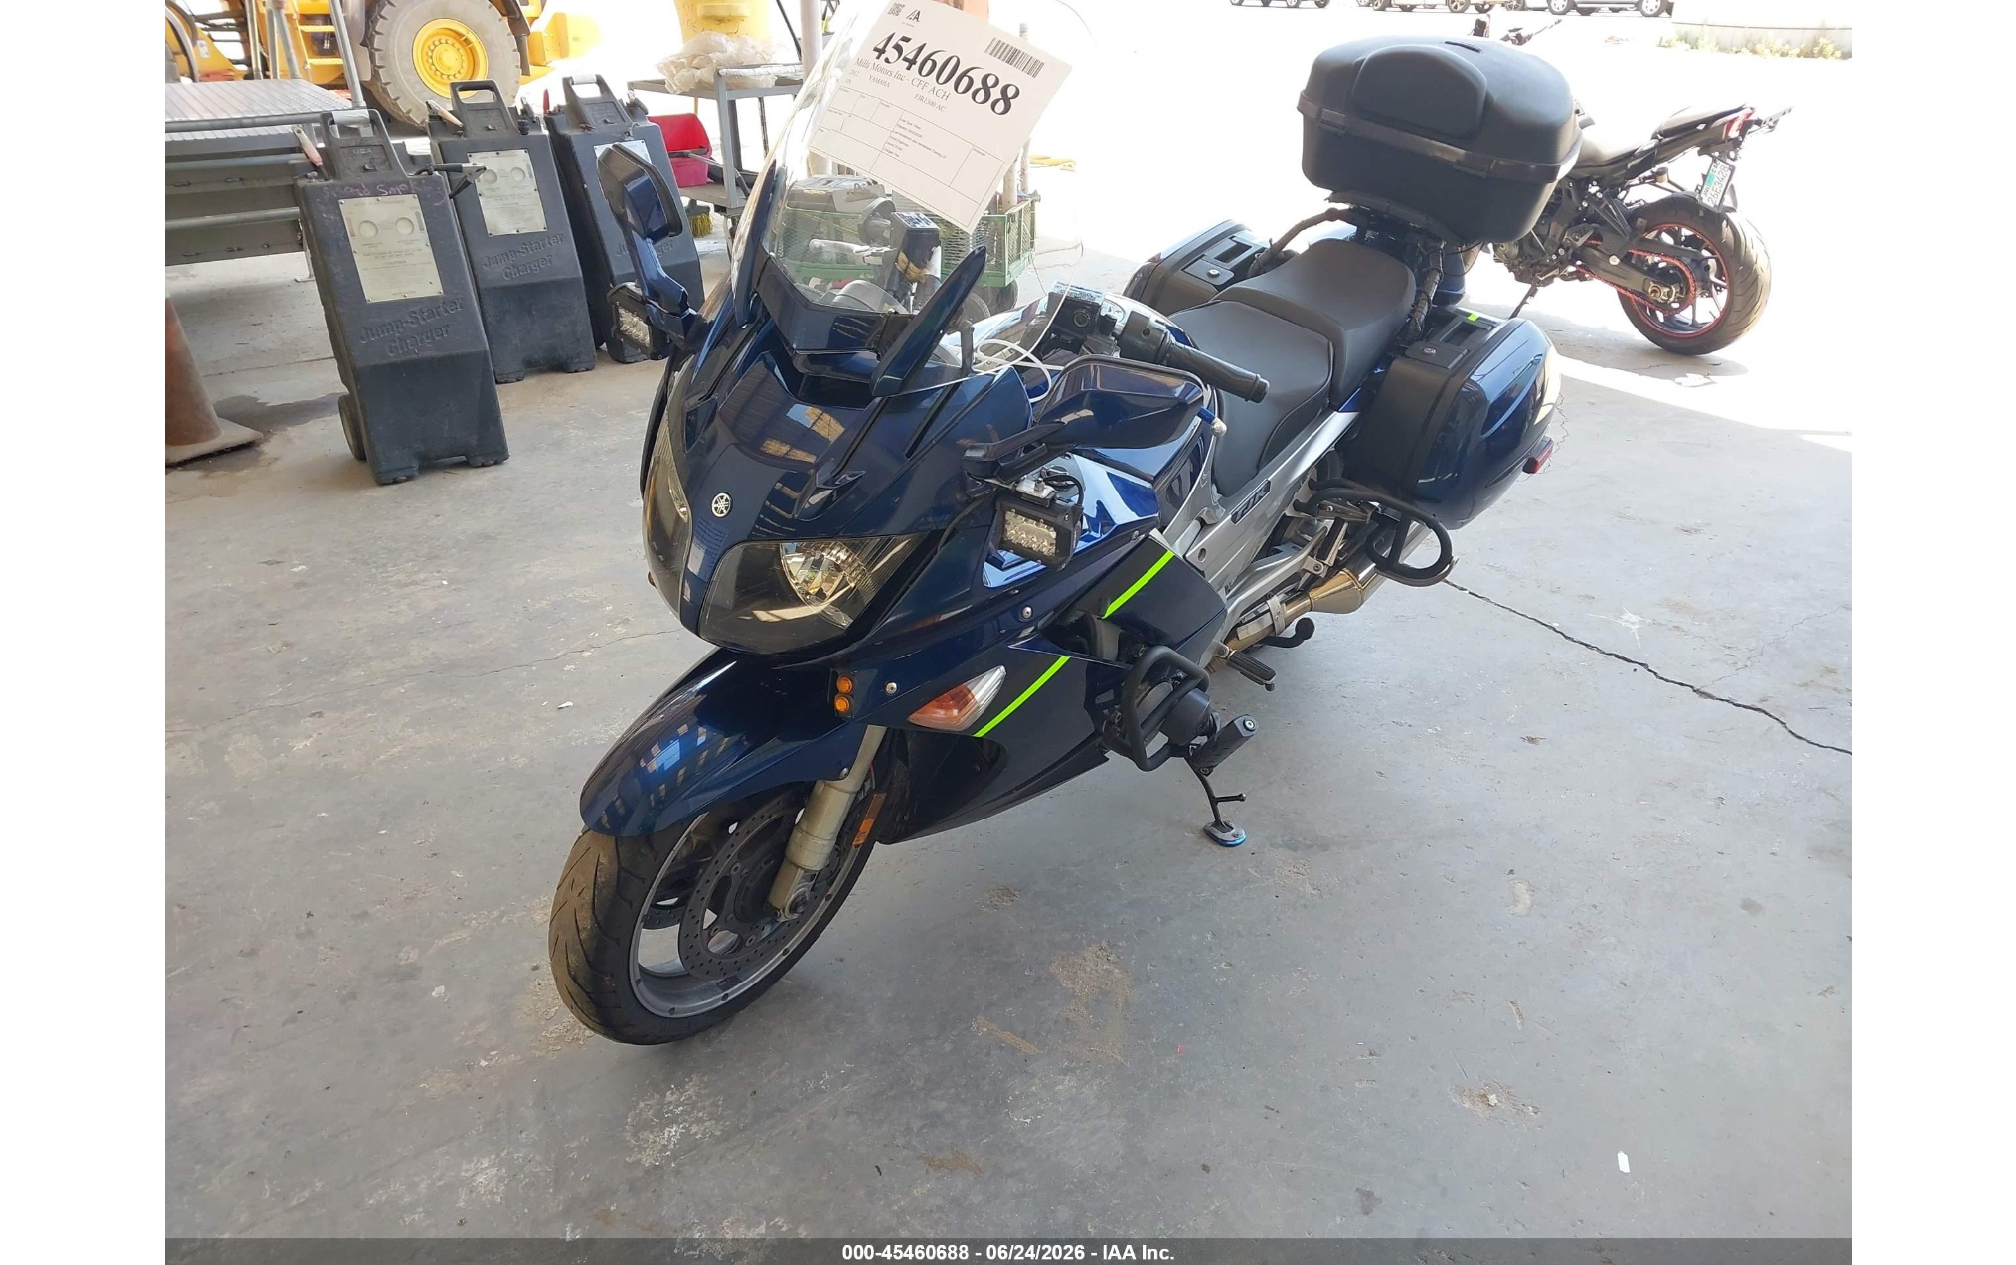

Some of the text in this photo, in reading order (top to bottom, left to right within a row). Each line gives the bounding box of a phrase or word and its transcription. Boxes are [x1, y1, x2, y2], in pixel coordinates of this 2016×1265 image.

[855, 57, 871, 69] Mills
[870, 62, 893, 77] Motors
[893, 70, 906, 81] Inc
[911, 77, 930, 90] CFF
[928, 86, 951, 101] ACH
[873, 32, 1020, 116] 45460688
[869, 75, 890, 88] YAMAHA
[936, 104, 947, 112] AC
[482, 233, 564, 269] Jump-Starter
[502, 254, 552, 280] Charger
[358, 297, 464, 344] Jump-Starter
[386, 323, 451, 357] Charger
